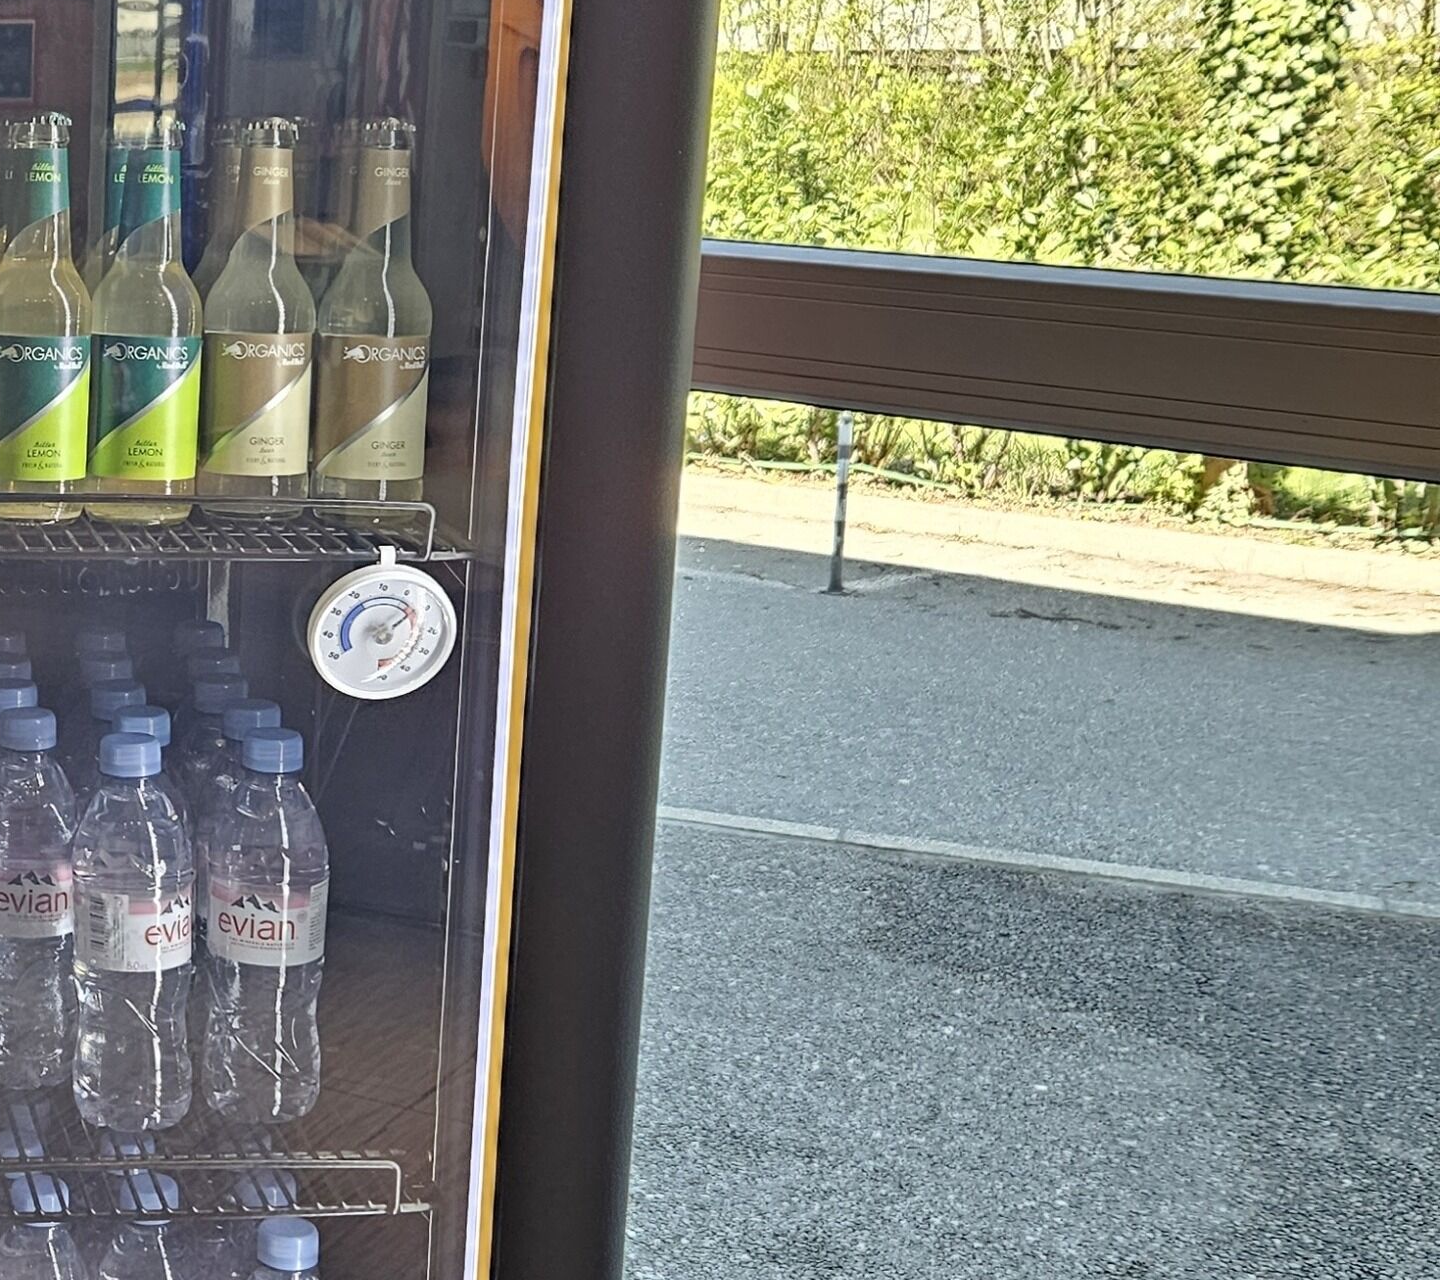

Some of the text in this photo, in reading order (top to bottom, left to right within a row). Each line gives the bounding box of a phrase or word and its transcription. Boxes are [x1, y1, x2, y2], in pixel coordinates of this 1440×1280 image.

[25, 171, 61, 183] LEMON
[138, 172, 174, 184] LEMON
[9, 343, 83, 363] ORGANICS
[113, 342, 188, 361] ORGANICS
[234, 340, 305, 360] ORGANICS
[356, 344, 426, 364] ORGANICS
[249, 436, 285, 447] GINGER
[370, 440, 406, 451] GINGER
[26, 448, 61, 459] LEMON
[127, 447, 164, 457] LEMON
[378, 582, 389, 592] 10
[348, 590, 361, 600] 20
[330, 607, 342, 616] 30
[322, 630, 334, 640] 40
[327, 651, 340, 661] 50
[418, 647, 430, 656] 30
[144, 913, 191, 947] evia
[217, 911, 296, 942] evian
